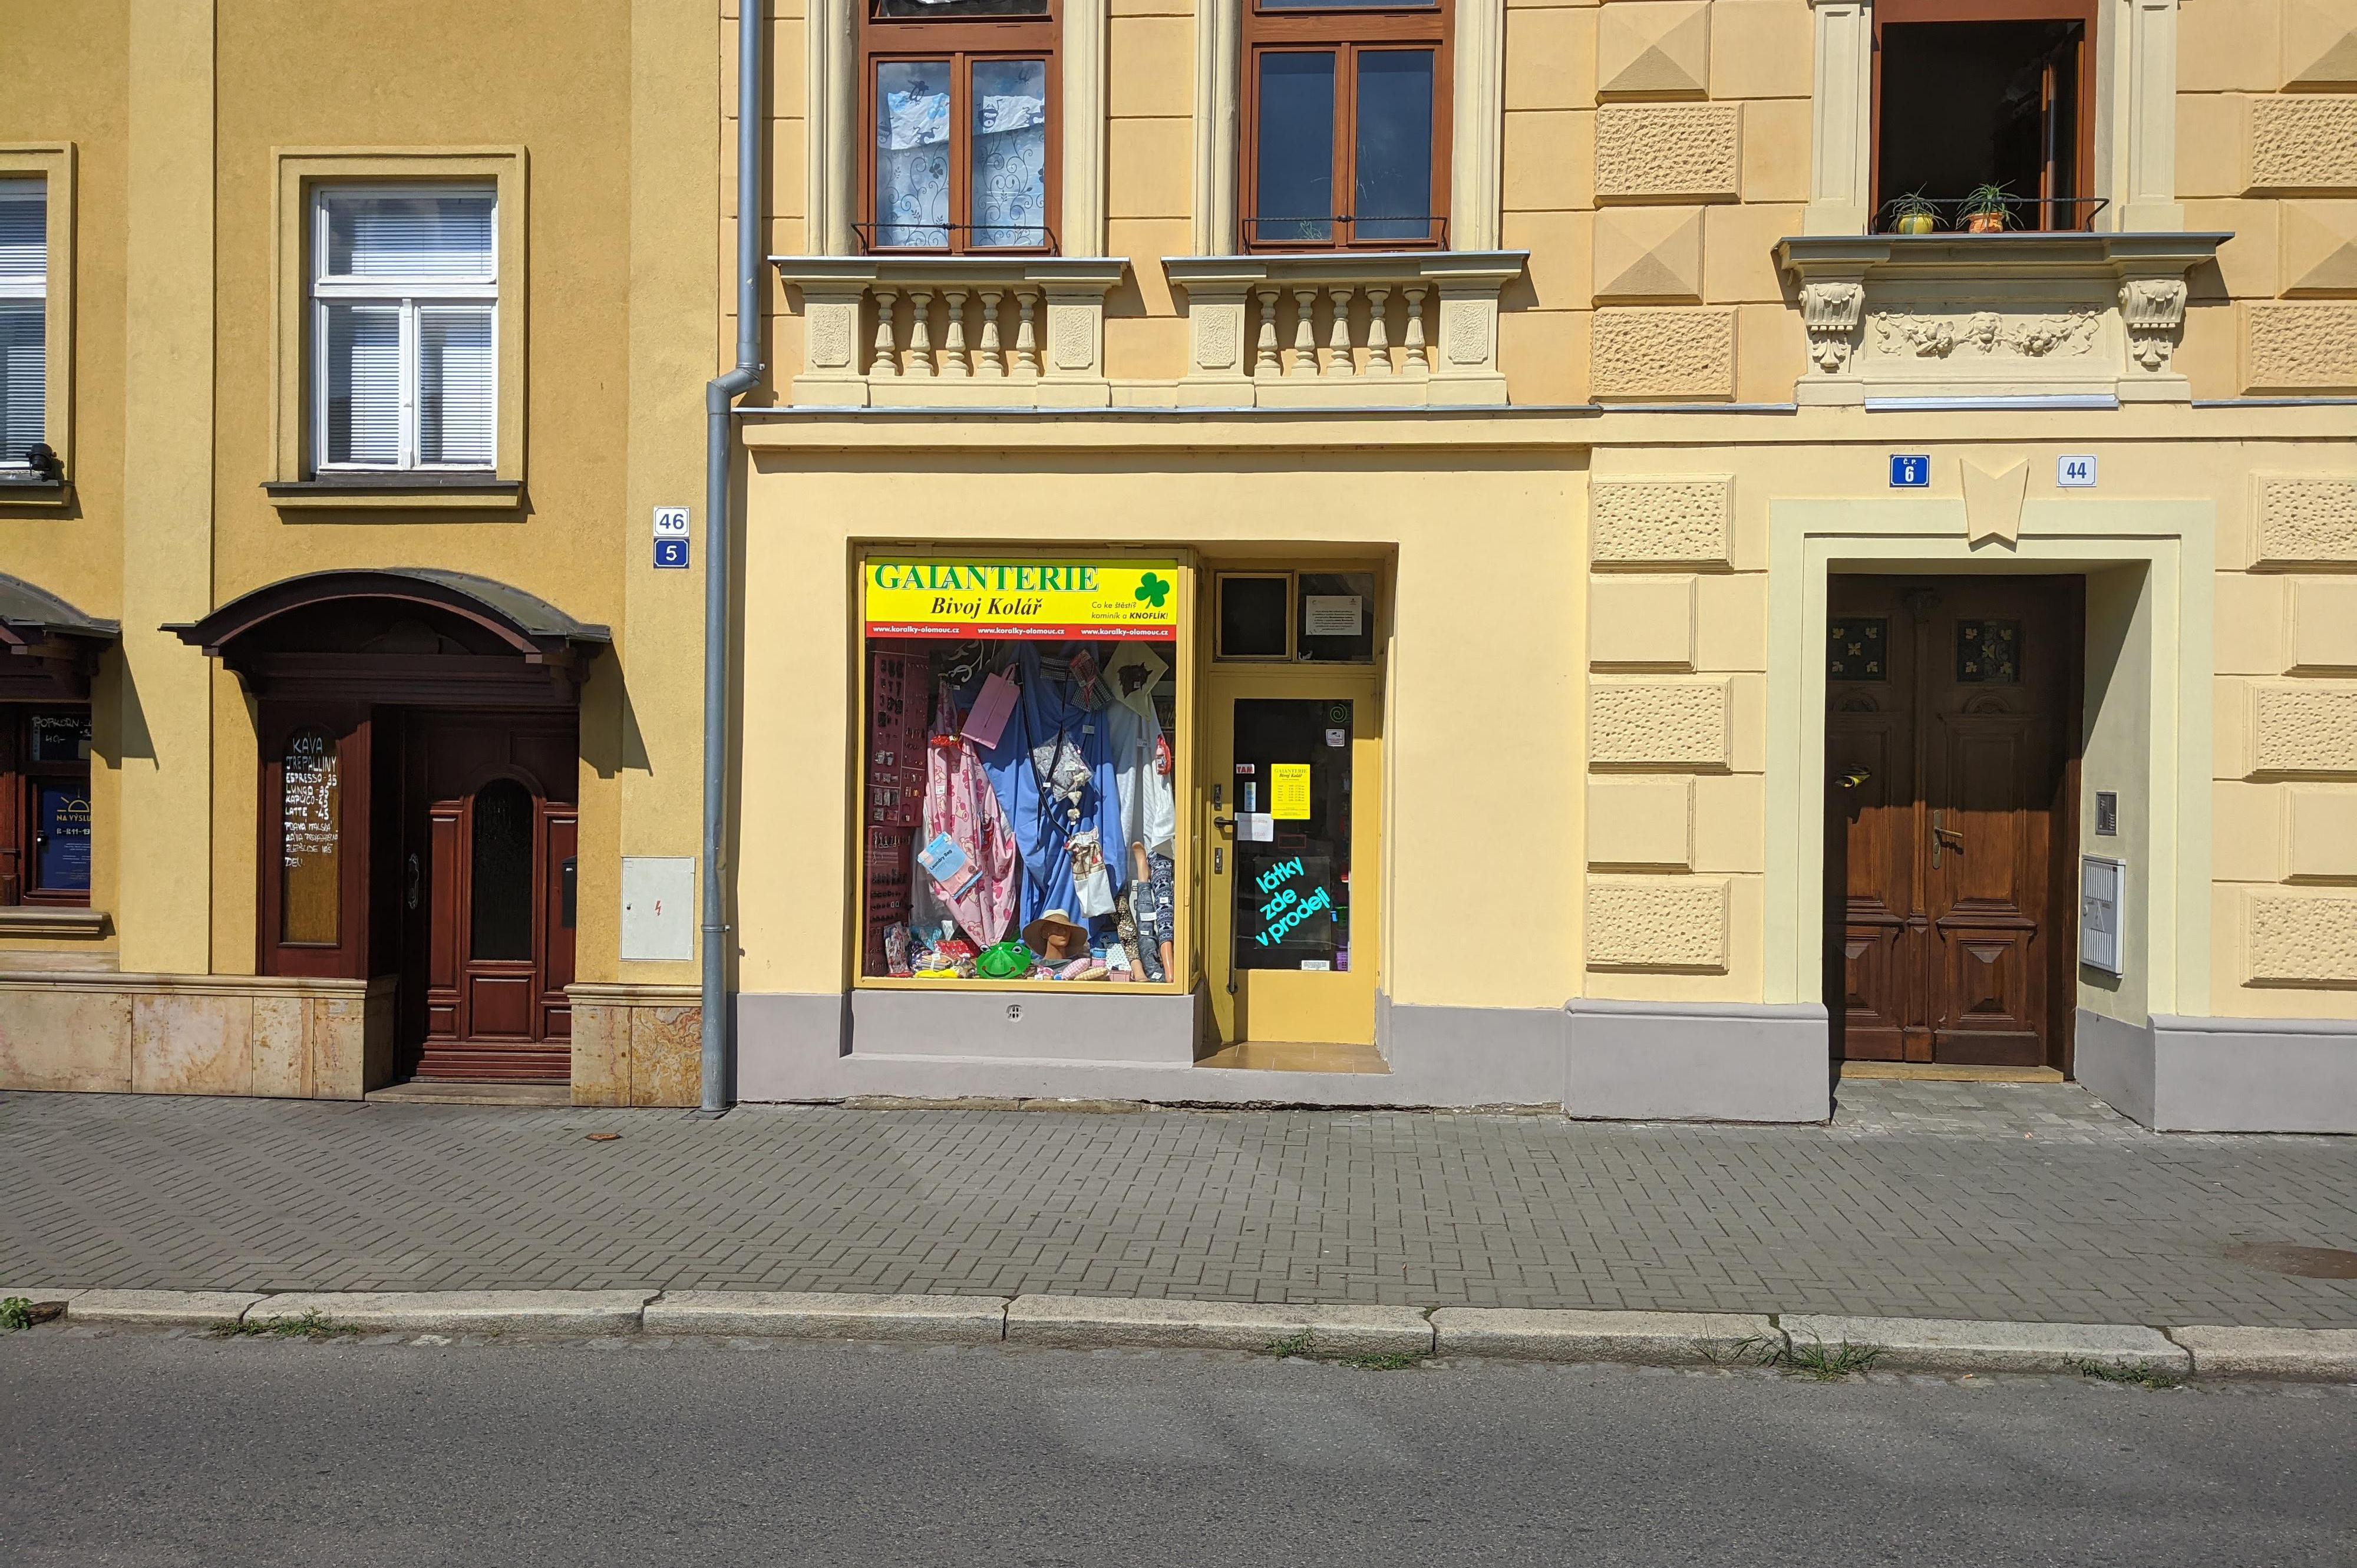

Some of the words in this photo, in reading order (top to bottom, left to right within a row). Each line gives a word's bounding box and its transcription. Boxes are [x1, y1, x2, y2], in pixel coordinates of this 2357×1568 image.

[1905, 466, 1914, 482] 6
[2066, 462, 2087, 479] 44
[659, 513, 684, 530] 46
[665, 545, 678, 562] 5
[874, 563, 1100, 592] GALANTERIE
[930, 596, 981, 619] Bivoj
[986, 597, 1044, 616] Kolář
[1104, 600, 1113, 609] ke
[1129, 610, 1168, 620] KNOFLÍK!
[873, 625, 960, 635] www.koralky-olomouc.cz
[977, 627, 1065, 636] www.koralky-olomouc.cz
[1080, 628, 1168, 636] www.koralky-olomouc.cz
[292, 731, 323, 754] KÁVA
[286, 772, 322, 784] ESPRESSO
[286, 784, 313, 795] LUNGO
[285, 807, 308, 817] LATTE
[929, 856, 945, 870] Laundry
[1256, 856, 1304, 894] látky
[1259, 889, 1297, 920] zde
[1256, 932, 1269, 946] v
[1268, 886, 1331, 944] prodeji
